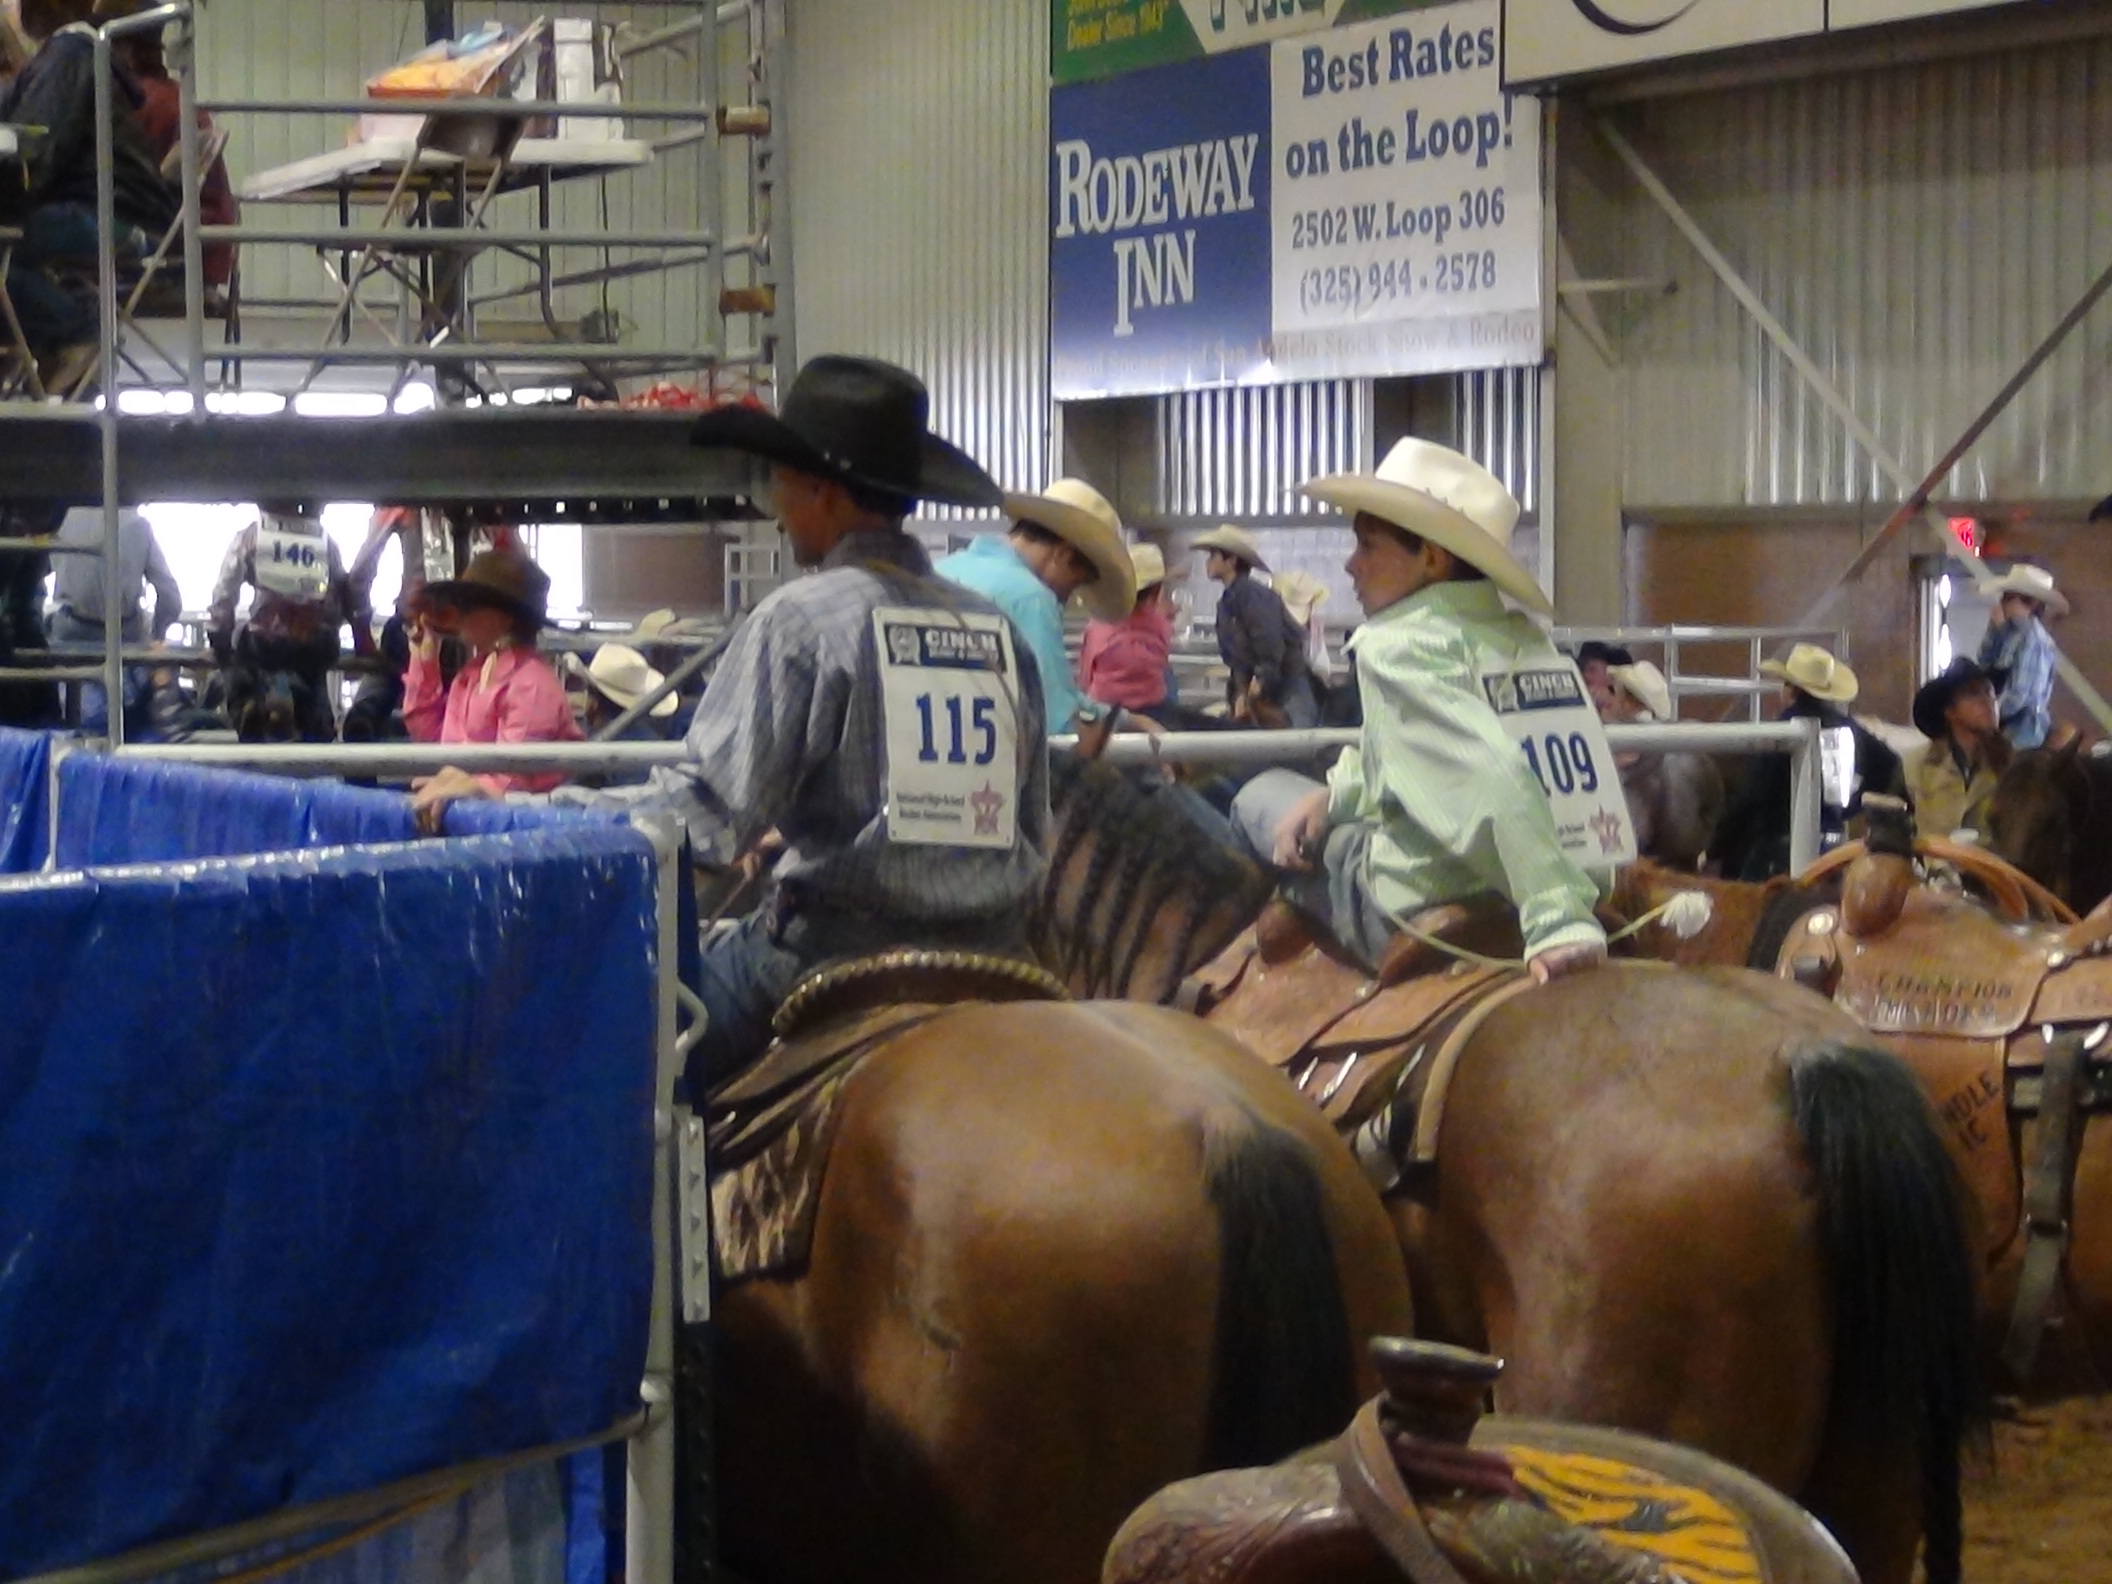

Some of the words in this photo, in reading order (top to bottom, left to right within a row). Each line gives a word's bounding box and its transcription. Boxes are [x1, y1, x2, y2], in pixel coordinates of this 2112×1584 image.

[1302, 36, 1379, 98] Best
[1389, 23, 1495, 82] Rates
[1285, 142, 1330, 180] on
[1338, 117, 1395, 172] the
[1404, 94, 1514, 168] Loop!
[1056, 133, 1259, 237] RODEWAY
[1292, 207, 1348, 250] 2502
[1458, 187, 1506, 229] 306
[1113, 230, 1196, 336] INN
[1300, 265, 1361, 315] (325)
[1368, 259, 1412, 302] 944
[1435, 250, 1497, 291] 2578
[916, 691, 997, 766] 115
[1520, 731, 1598, 797] 109
